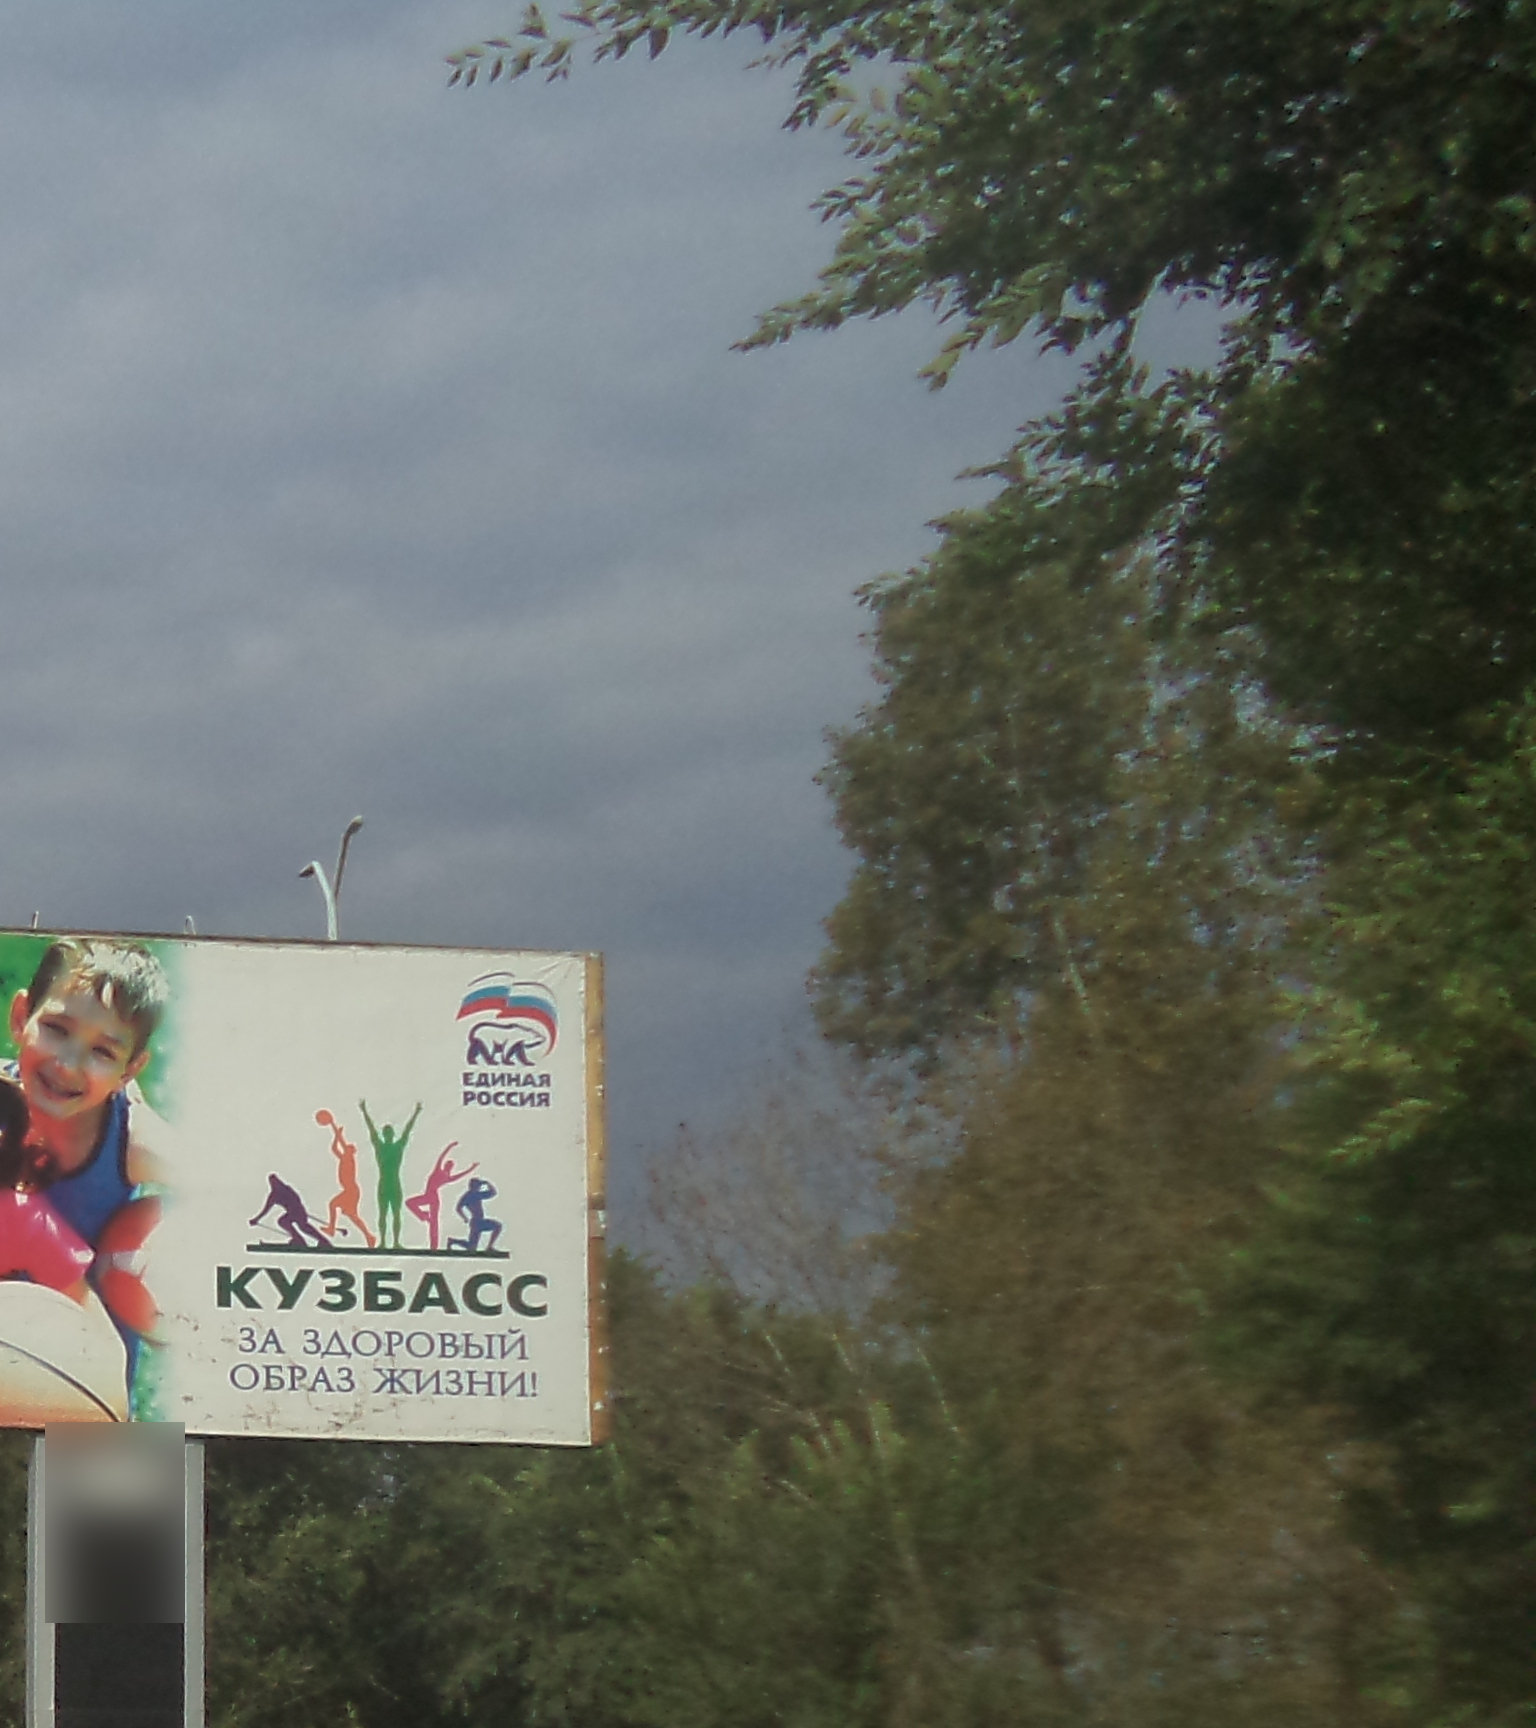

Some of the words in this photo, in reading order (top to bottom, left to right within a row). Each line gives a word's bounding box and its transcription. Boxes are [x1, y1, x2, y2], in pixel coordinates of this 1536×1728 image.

[462, 1071, 552, 1090] ЕДИНАЯ
[462, 1090, 551, 1108] РОССИЯ
[216, 1266, 549, 1317] КУЗБАСС
[238, 1327, 285, 1355] ЗА
[303, 1328, 528, 1361] ЗДОРОВЫЙ
[229, 1364, 355, 1394] ОБРАЗ
[372, 1368, 538, 1398] ЖИЗНИ!
